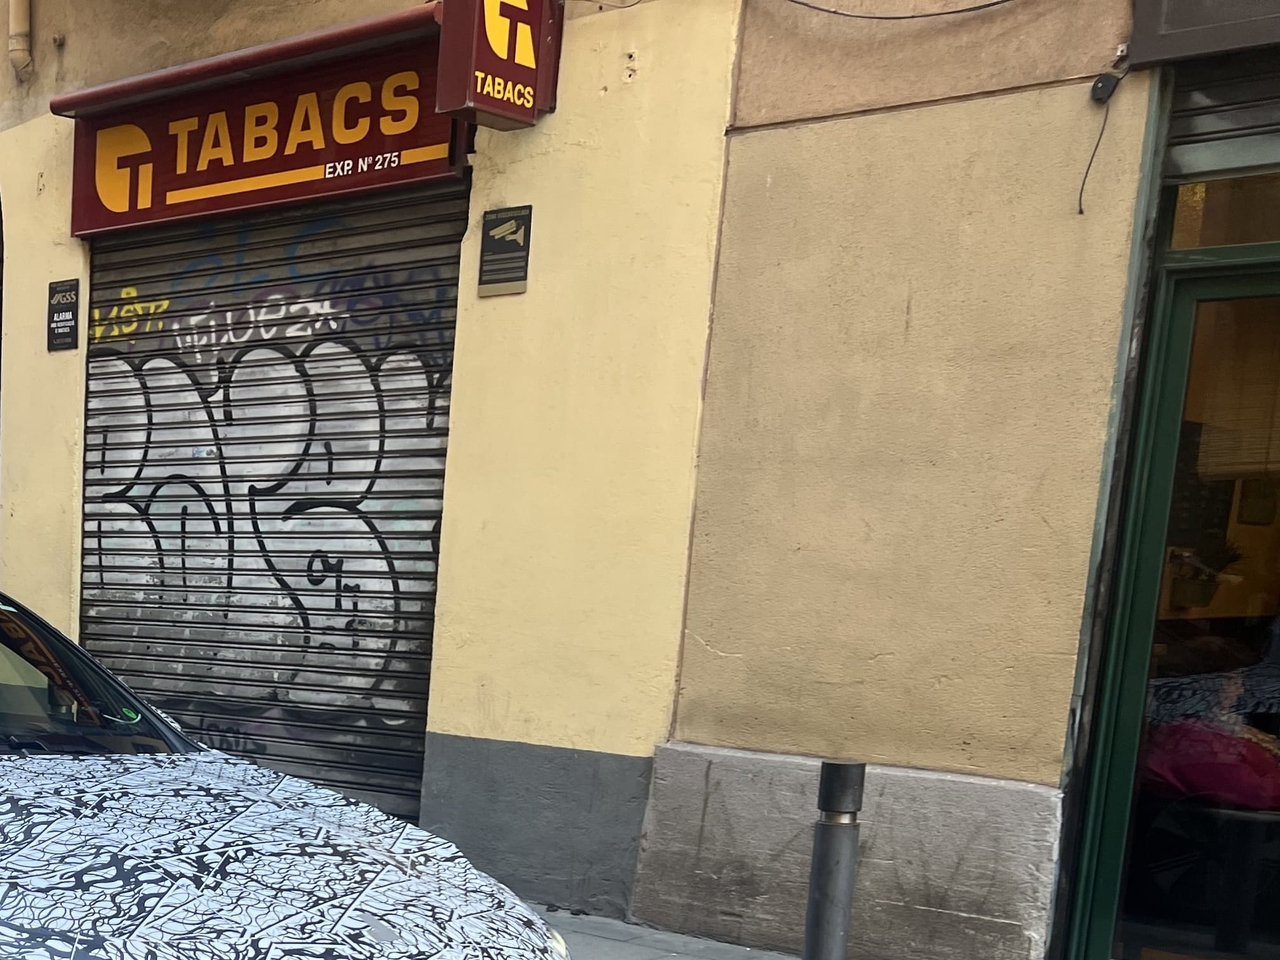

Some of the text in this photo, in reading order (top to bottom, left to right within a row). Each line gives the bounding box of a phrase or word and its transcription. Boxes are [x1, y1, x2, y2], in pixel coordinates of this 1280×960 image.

[474, 70, 534, 109] TABACS
[168, 70, 420, 175] TABACS
[324, 160, 353, 179] EXP.
[374, 151, 400, 171] 275
